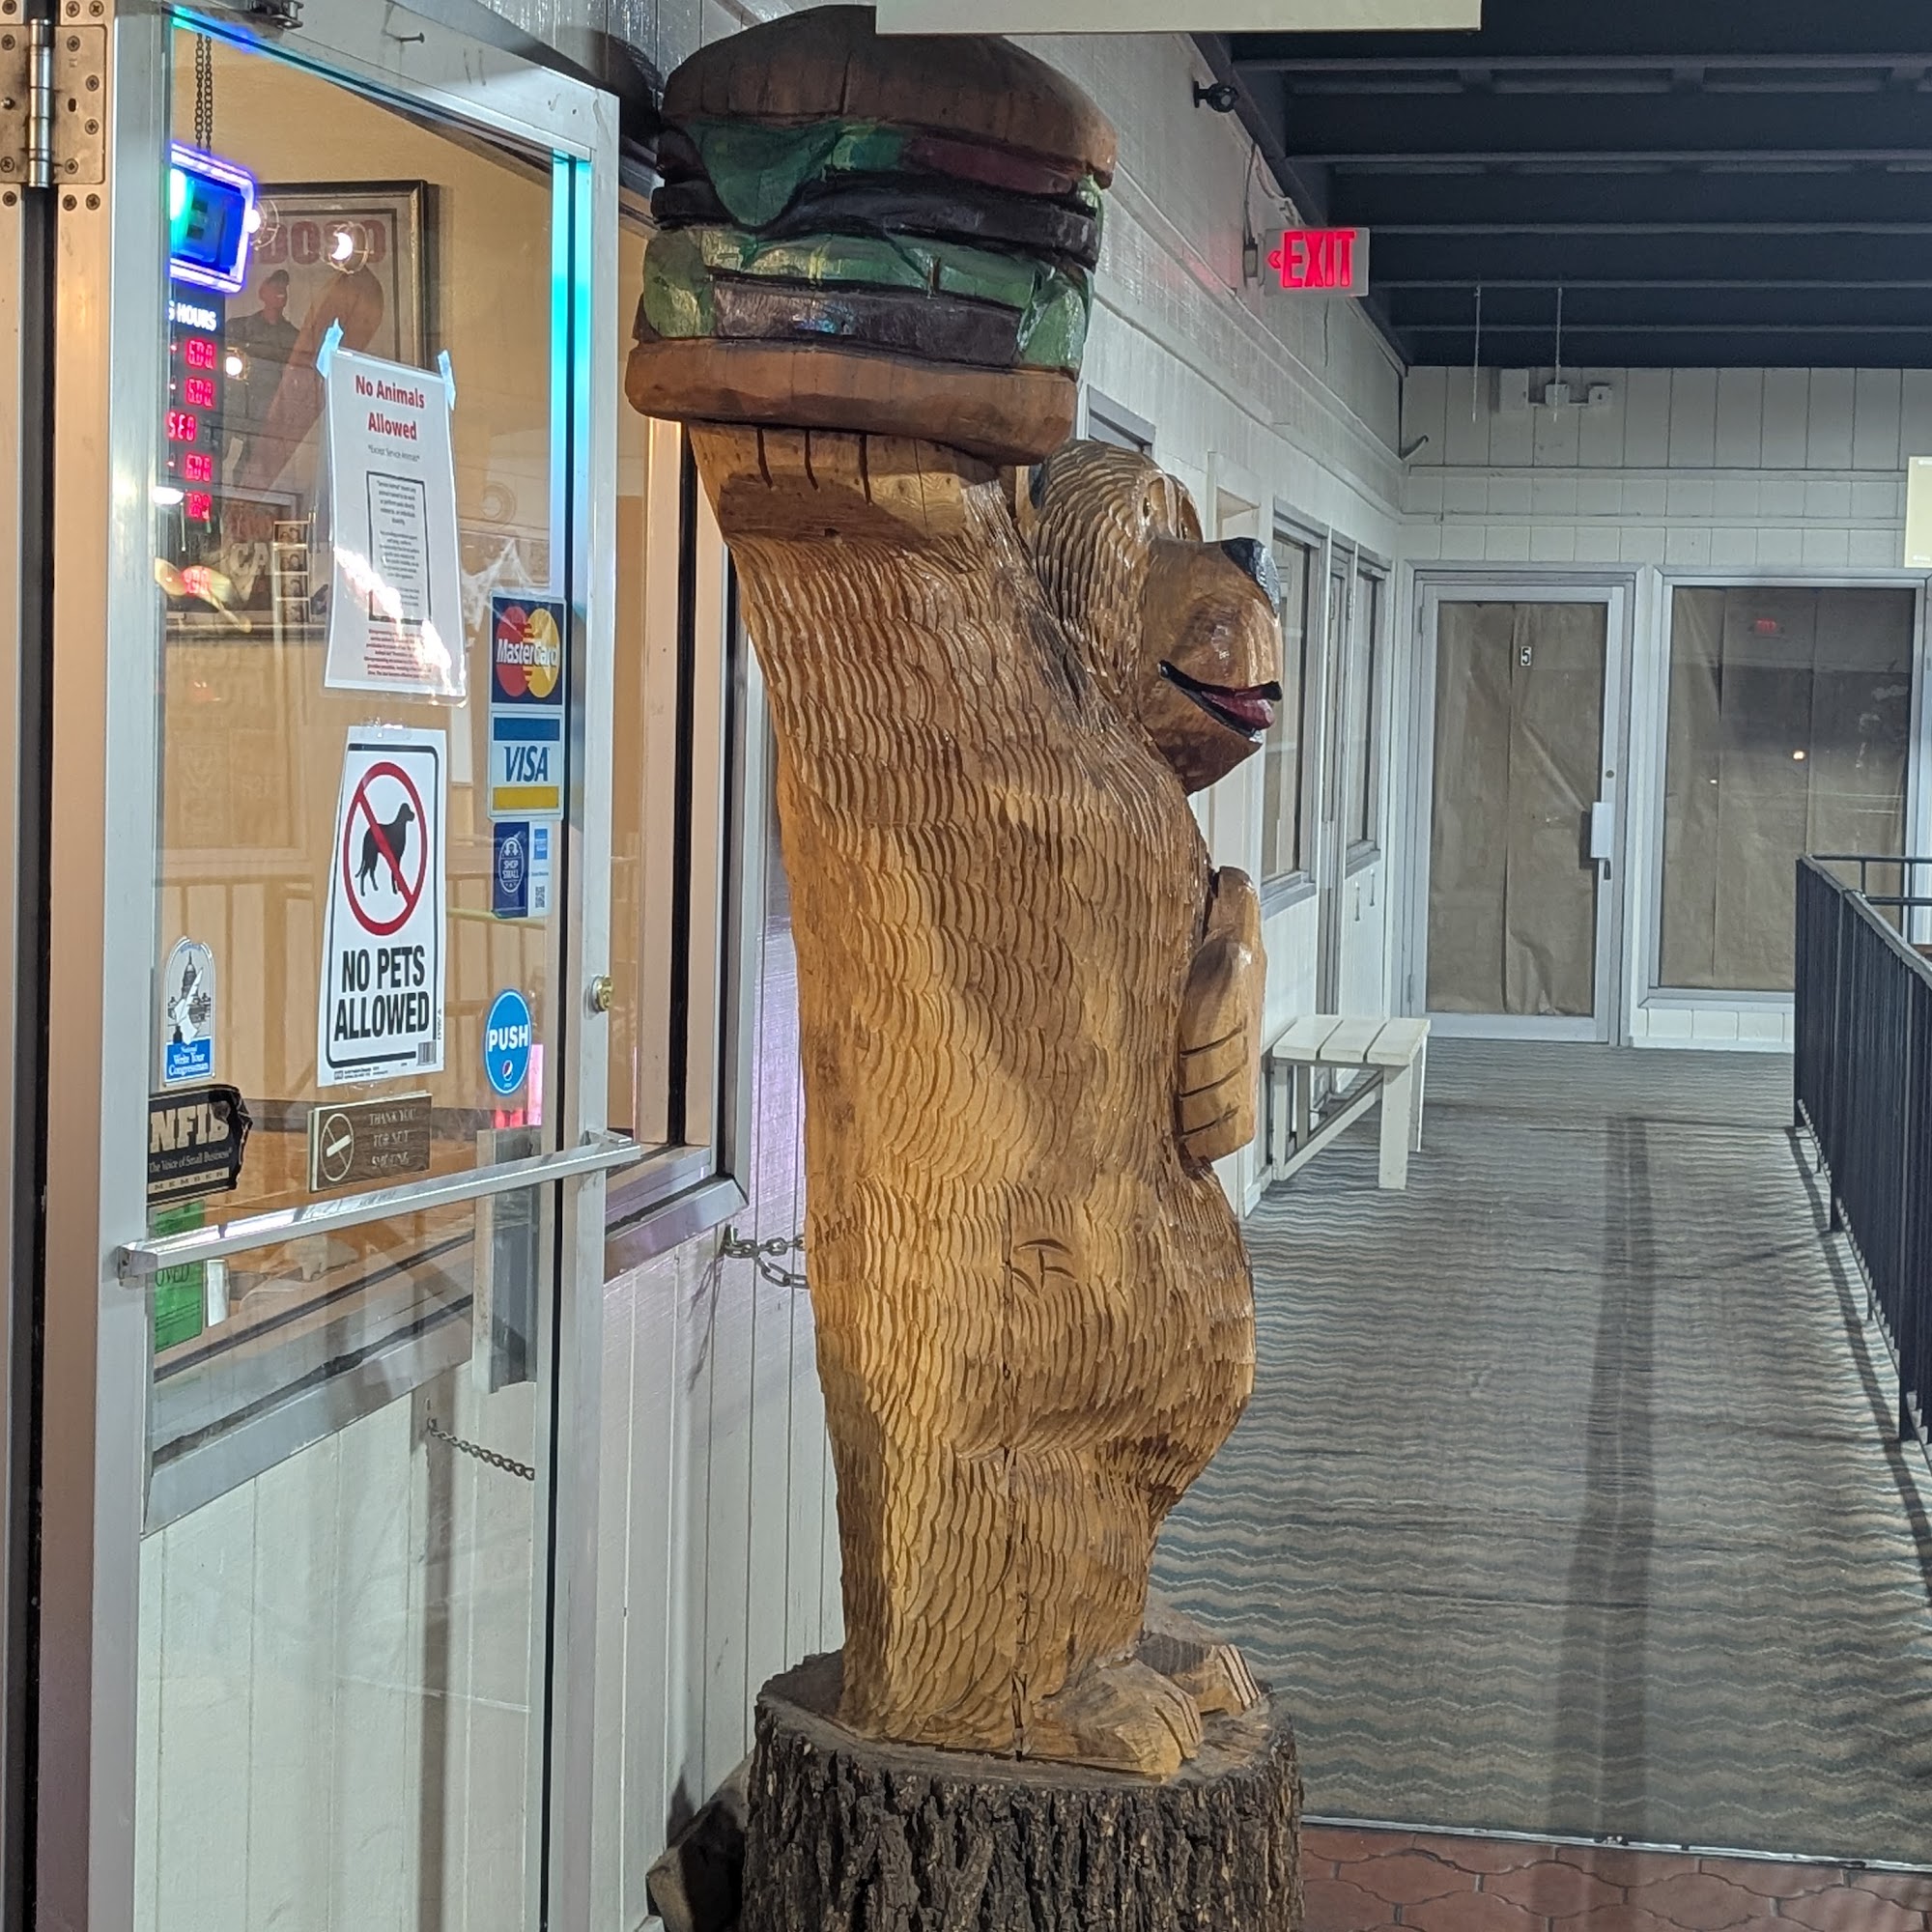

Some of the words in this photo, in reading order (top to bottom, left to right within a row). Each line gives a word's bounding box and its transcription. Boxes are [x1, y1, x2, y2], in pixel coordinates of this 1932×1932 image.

[1282, 231, 1355, 288] EXIT
[177, 302, 216, 331] HOURS
[355, 375, 373, 396] No
[377, 380, 425, 409] Animals
[368, 412, 417, 440] Allowed
[497, 639, 558, 668] MasterCard
[1522, 648, 1530, 665] 5
[503, 746, 549, 782] VISA
[342, 949, 370, 993] NO
[377, 945, 425, 989] PETS
[333, 991, 430, 1041] ALLOWED
[488, 1024, 528, 1052] PUSH
